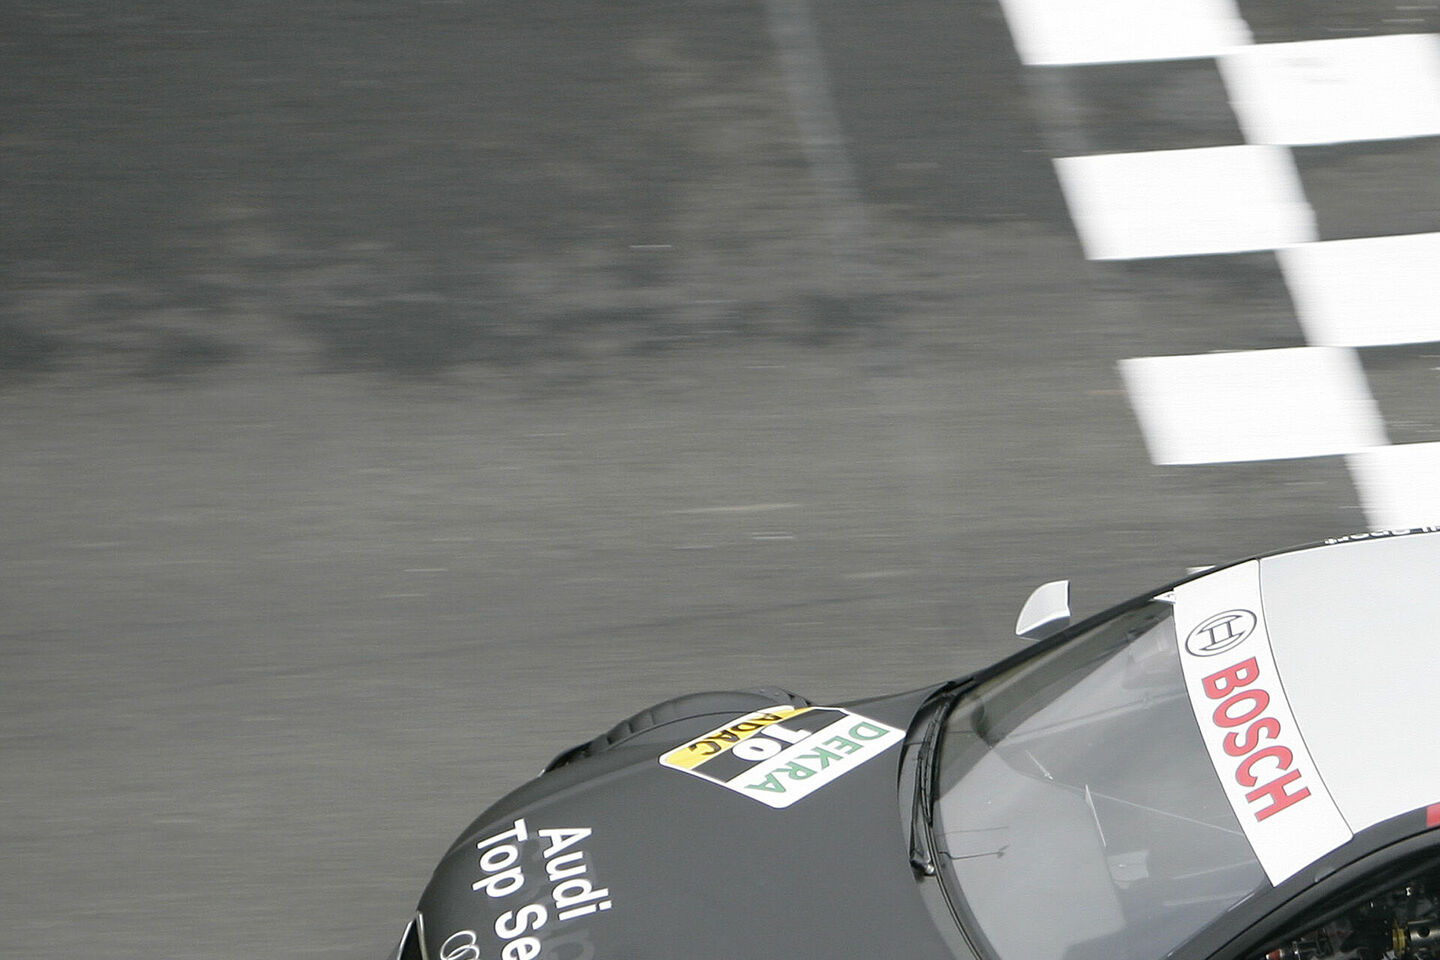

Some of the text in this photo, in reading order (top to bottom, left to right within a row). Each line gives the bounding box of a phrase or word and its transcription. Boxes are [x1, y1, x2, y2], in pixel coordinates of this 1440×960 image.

[689, 712, 783, 756] ADAC
[731, 723, 812, 761] 10
[744, 721, 890, 793] DEKRA
[1201, 656, 1311, 822] BOSCH
[472, 818, 528, 898] Top
[538, 827, 612, 921] Audi
